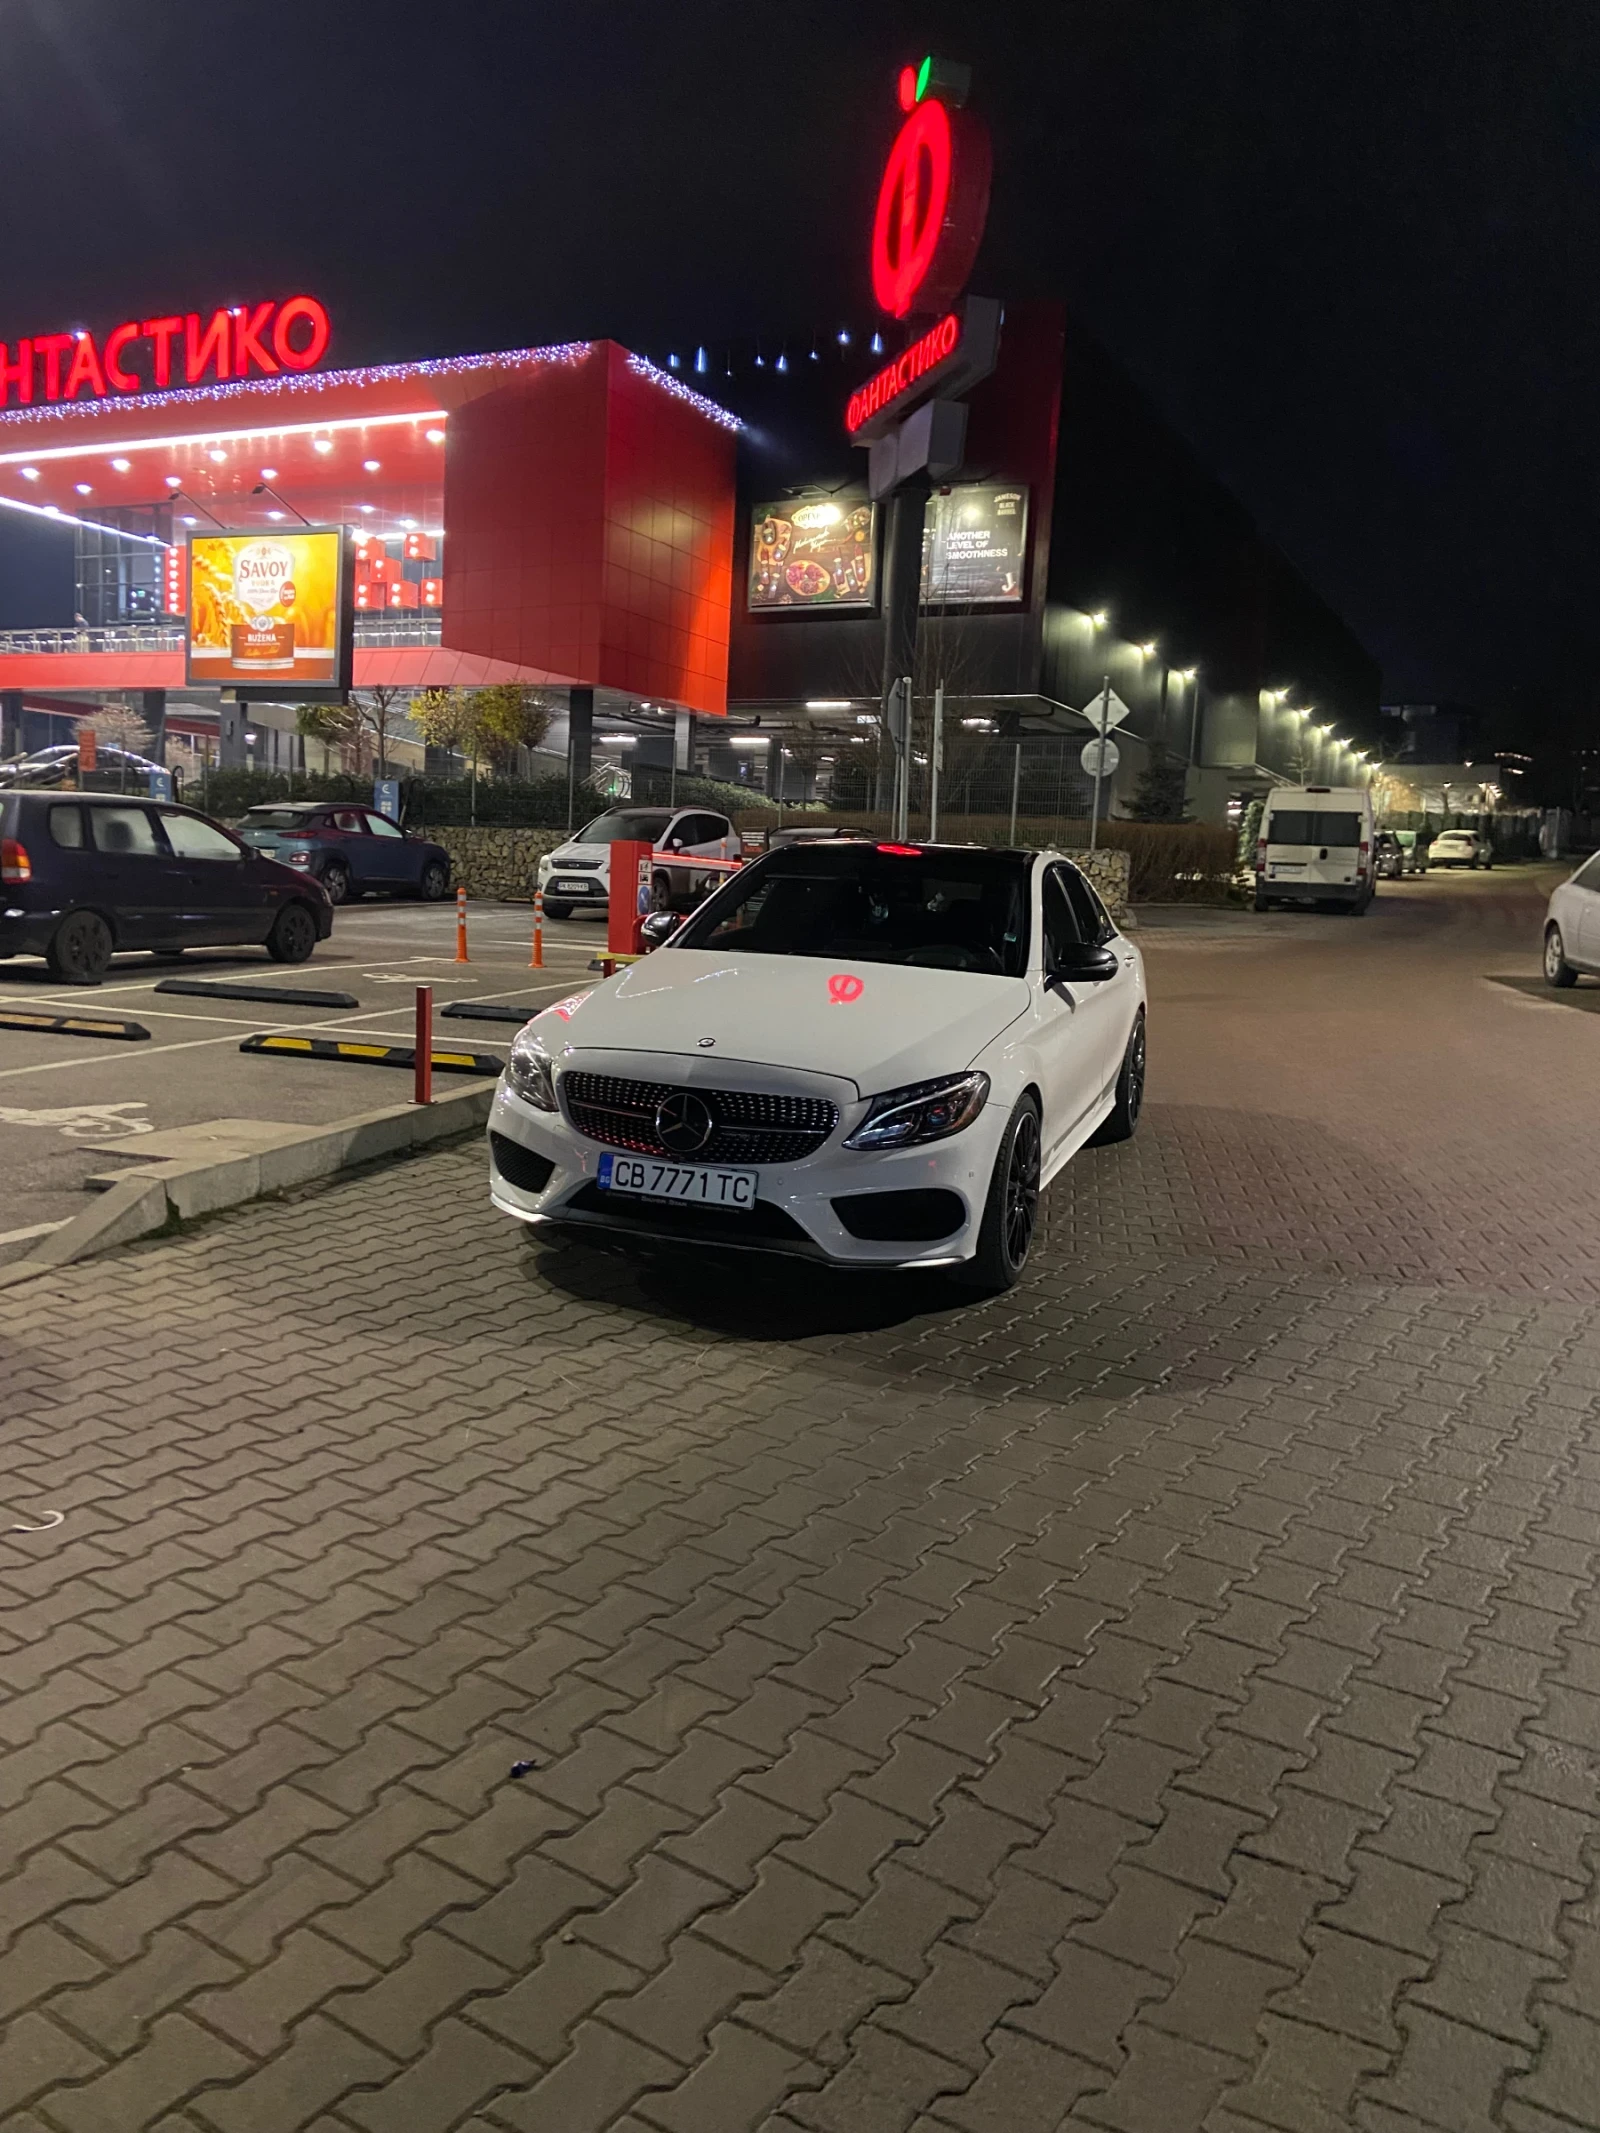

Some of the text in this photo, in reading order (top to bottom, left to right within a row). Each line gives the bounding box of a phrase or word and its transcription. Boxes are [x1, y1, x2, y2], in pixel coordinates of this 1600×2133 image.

[0, 295, 331, 407] НТАСТИКО
[846, 314, 960, 433] ФАНТАСТИКО
[946, 530, 991, 541] ANOTHER
[946, 540, 989, 550] LEVEL OF
[945, 548, 1008, 560] SMOOTHNESS
[239, 559, 287, 582] SAVOY
[615, 1161, 750, 1203] CB 7771 TC
